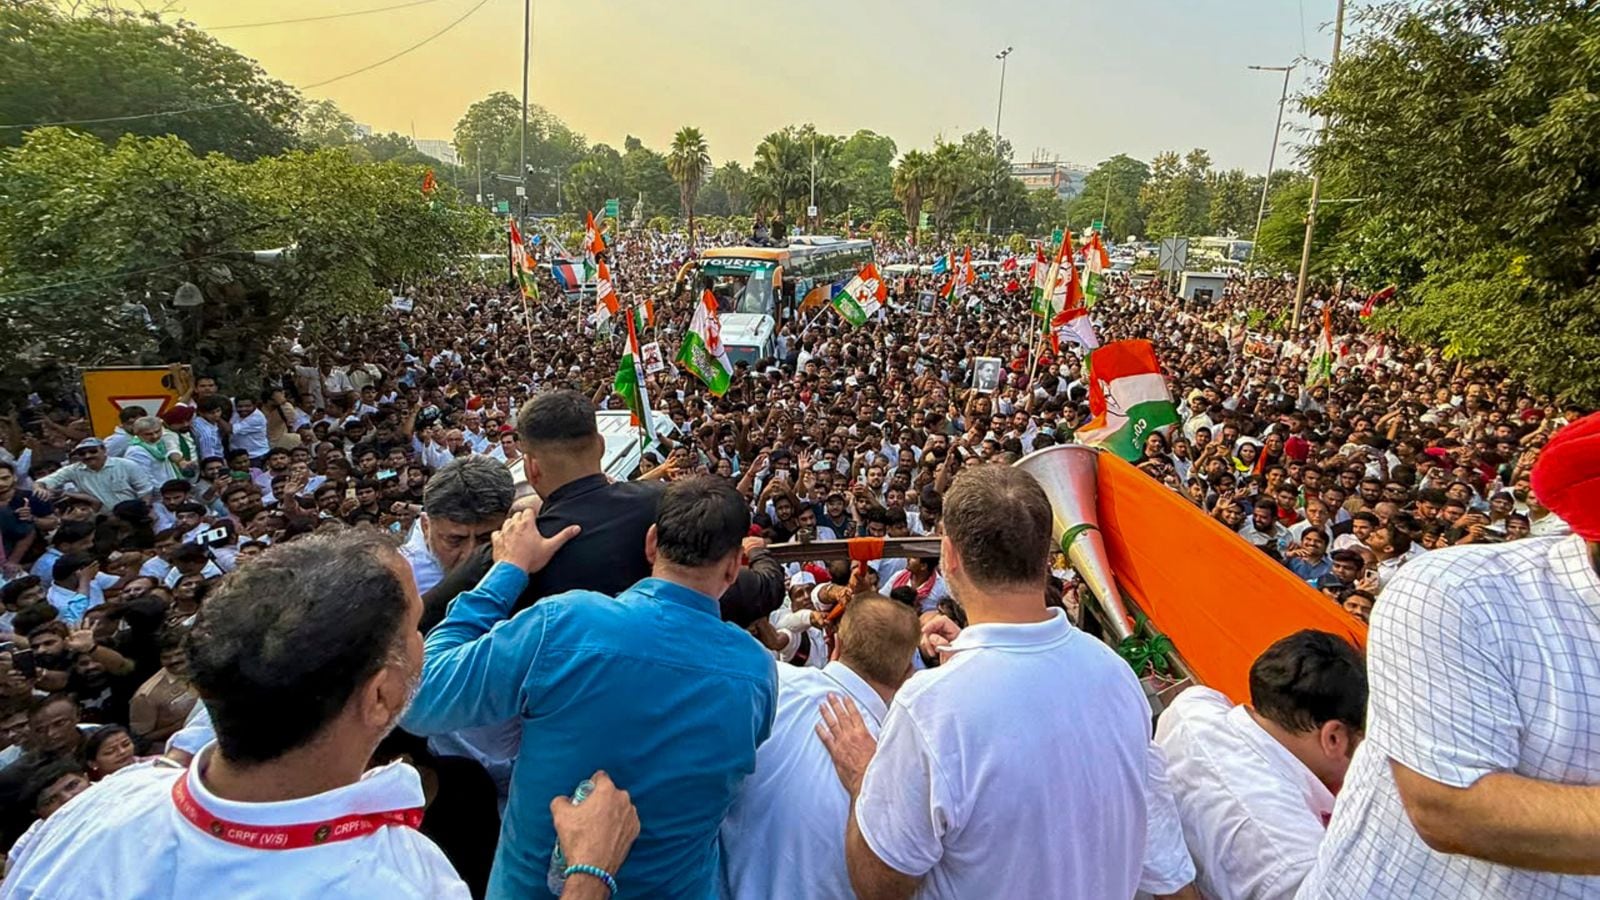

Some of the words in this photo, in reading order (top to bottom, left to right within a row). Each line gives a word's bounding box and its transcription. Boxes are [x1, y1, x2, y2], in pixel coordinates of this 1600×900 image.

[702, 258, 774, 269] TOURIST
[334, 820, 361, 836] CRPF
[227, 828, 258, 842] CRPF
[260, 833, 289, 846] (V/S)
